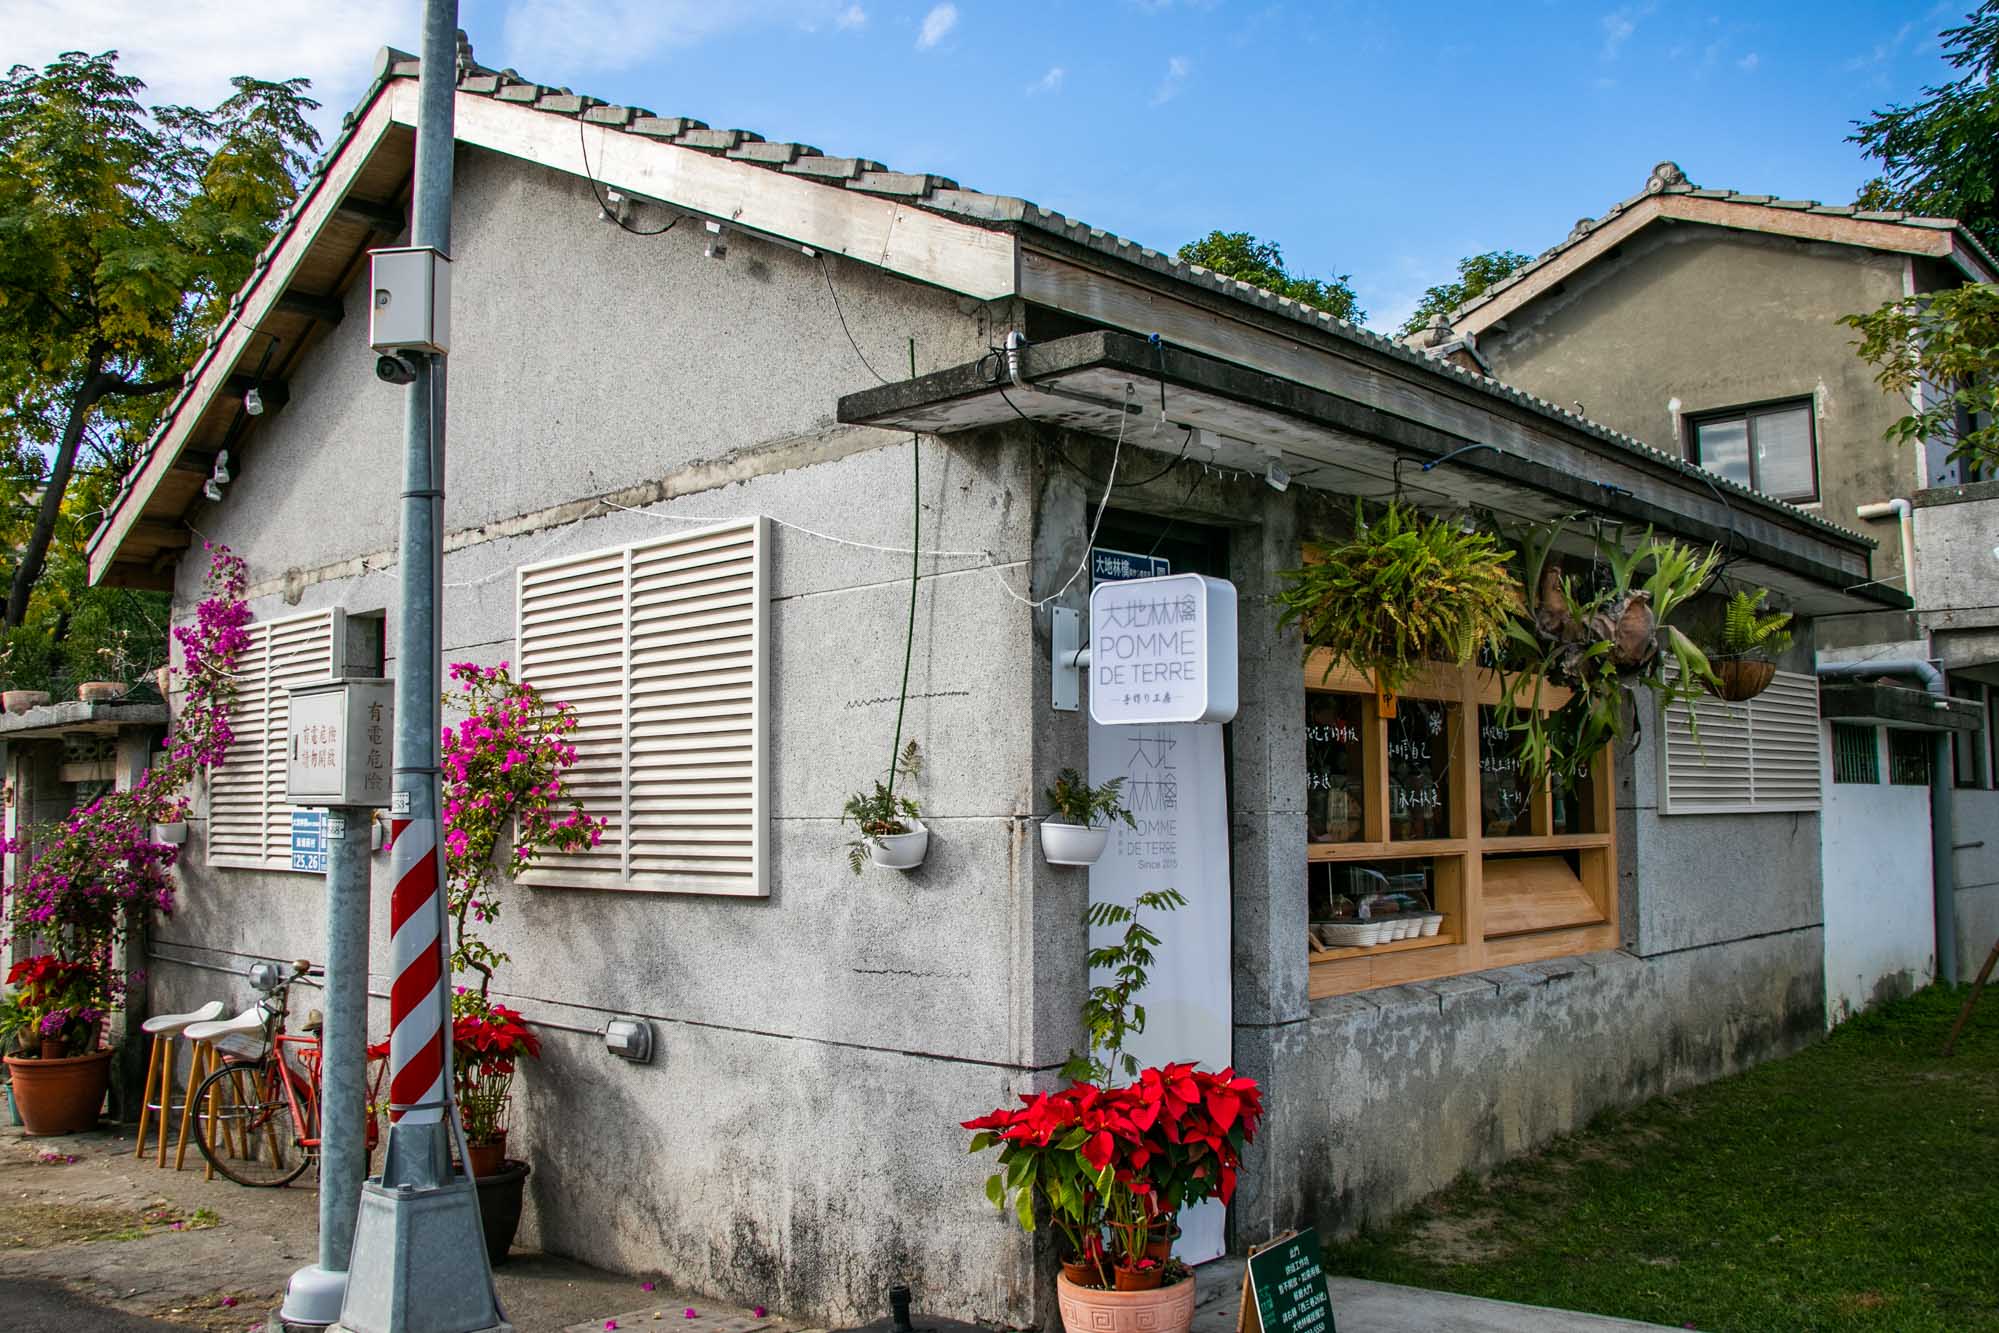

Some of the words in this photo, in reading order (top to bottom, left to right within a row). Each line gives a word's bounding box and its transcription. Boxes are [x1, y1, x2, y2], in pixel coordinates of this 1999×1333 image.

[1101, 631, 1196, 661] POMME
[1100, 665, 1125, 685] DE
[1133, 661, 1196, 683] TERRE
[364, 701, 384, 791] 有電危險
